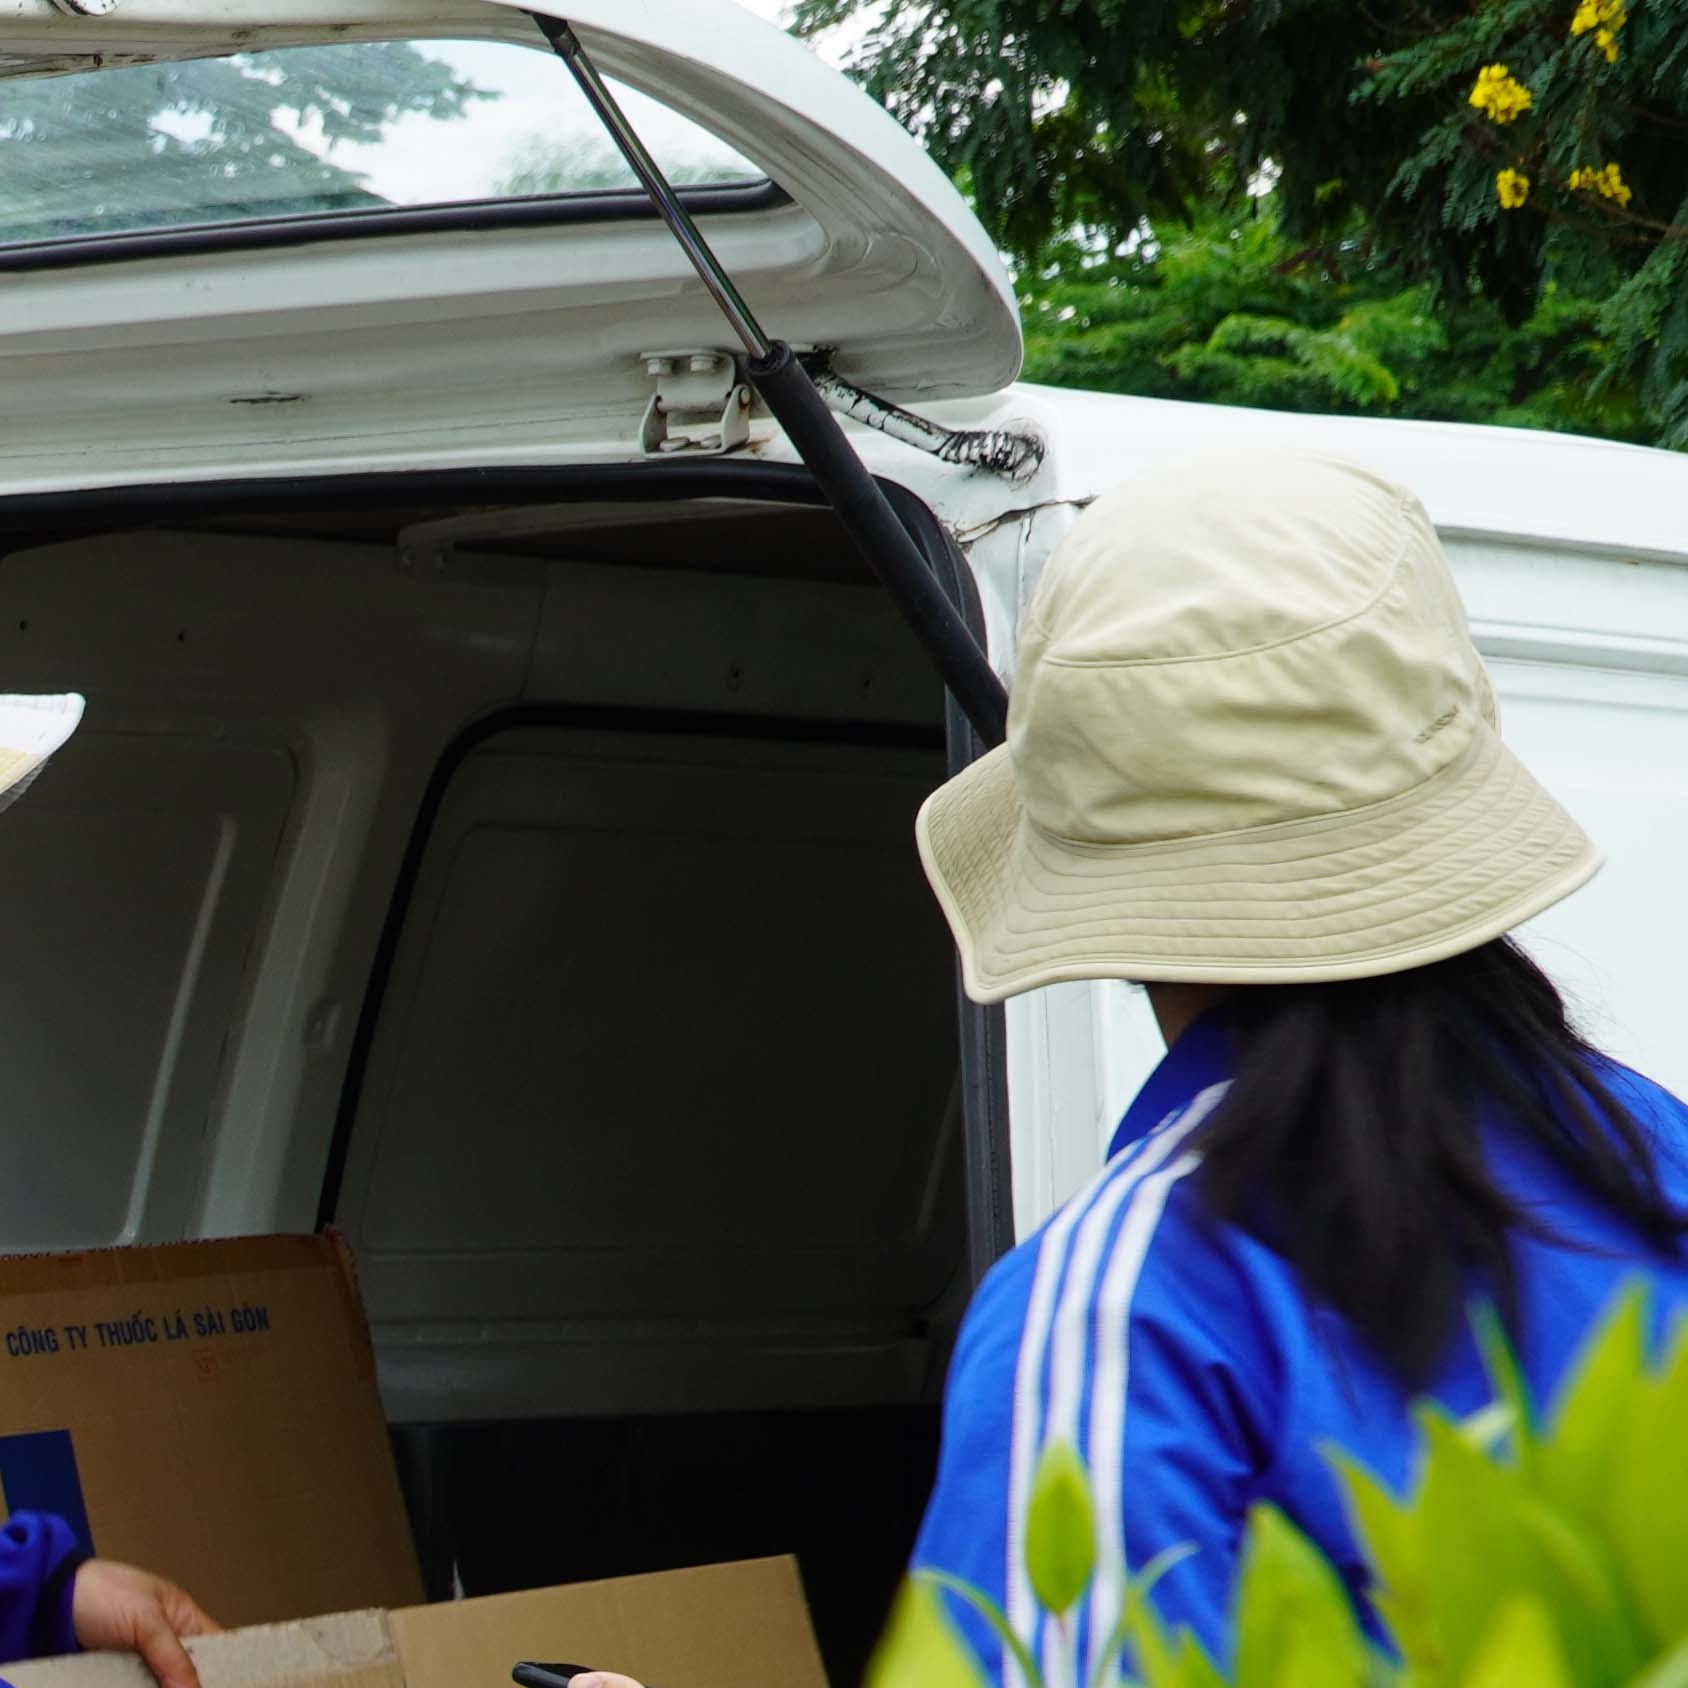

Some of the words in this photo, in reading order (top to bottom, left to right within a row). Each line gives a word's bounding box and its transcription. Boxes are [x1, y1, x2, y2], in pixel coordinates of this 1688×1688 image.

[6, 1326, 59, 1356] CÔNG
[64, 1325, 87, 1349] TY
[95, 1310, 158, 1346] THUỐC
[164, 1310, 189, 1340] LÁ
[193, 1307, 226, 1336] SÀI
[231, 1303, 270, 1332] GÒN
